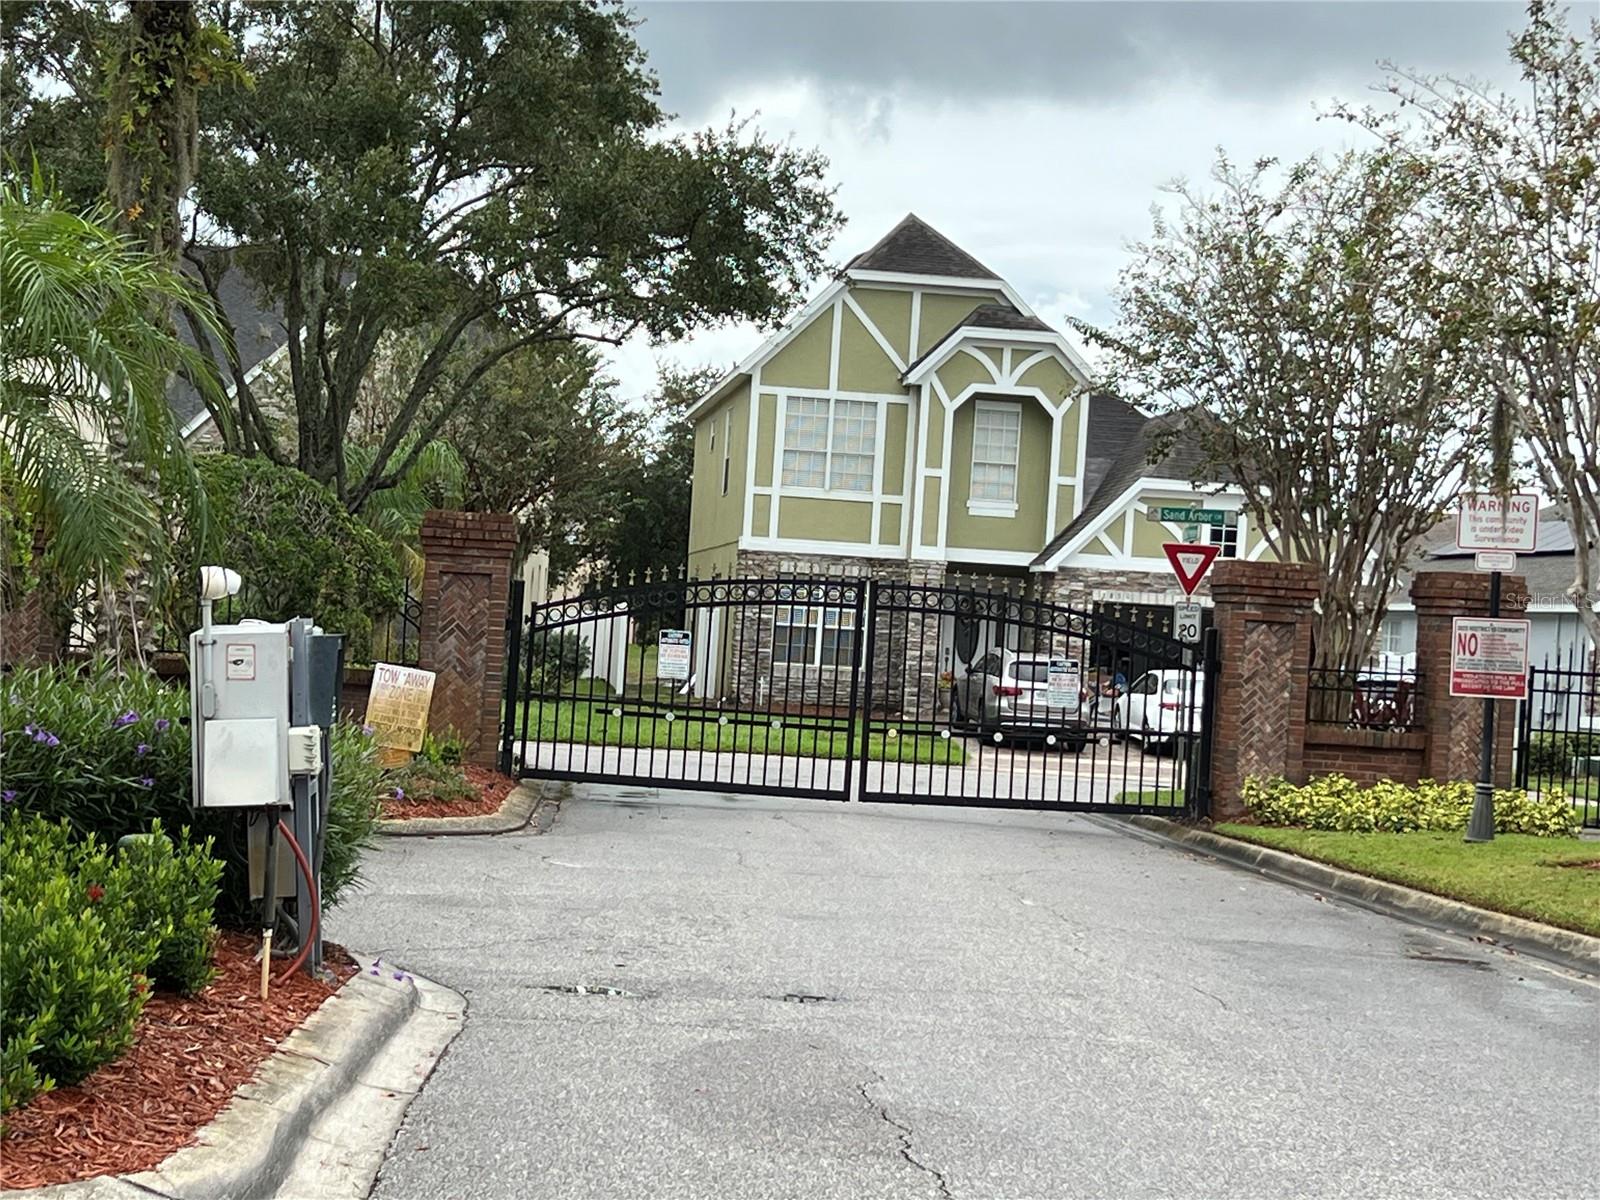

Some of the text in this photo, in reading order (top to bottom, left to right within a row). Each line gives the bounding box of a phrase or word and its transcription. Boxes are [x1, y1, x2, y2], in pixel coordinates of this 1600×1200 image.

[1467, 499, 1531, 513] WARNING
[1163, 509, 1185, 520] Sand
[1188, 511, 1212, 522] Arbor
[1469, 514, 1483, 523] This
[1178, 623, 1197, 640] 20
[1457, 632, 1478, 657] NO
[379, 667, 431, 688] TOW AWAY
[389, 685, 413, 702] ZONE
